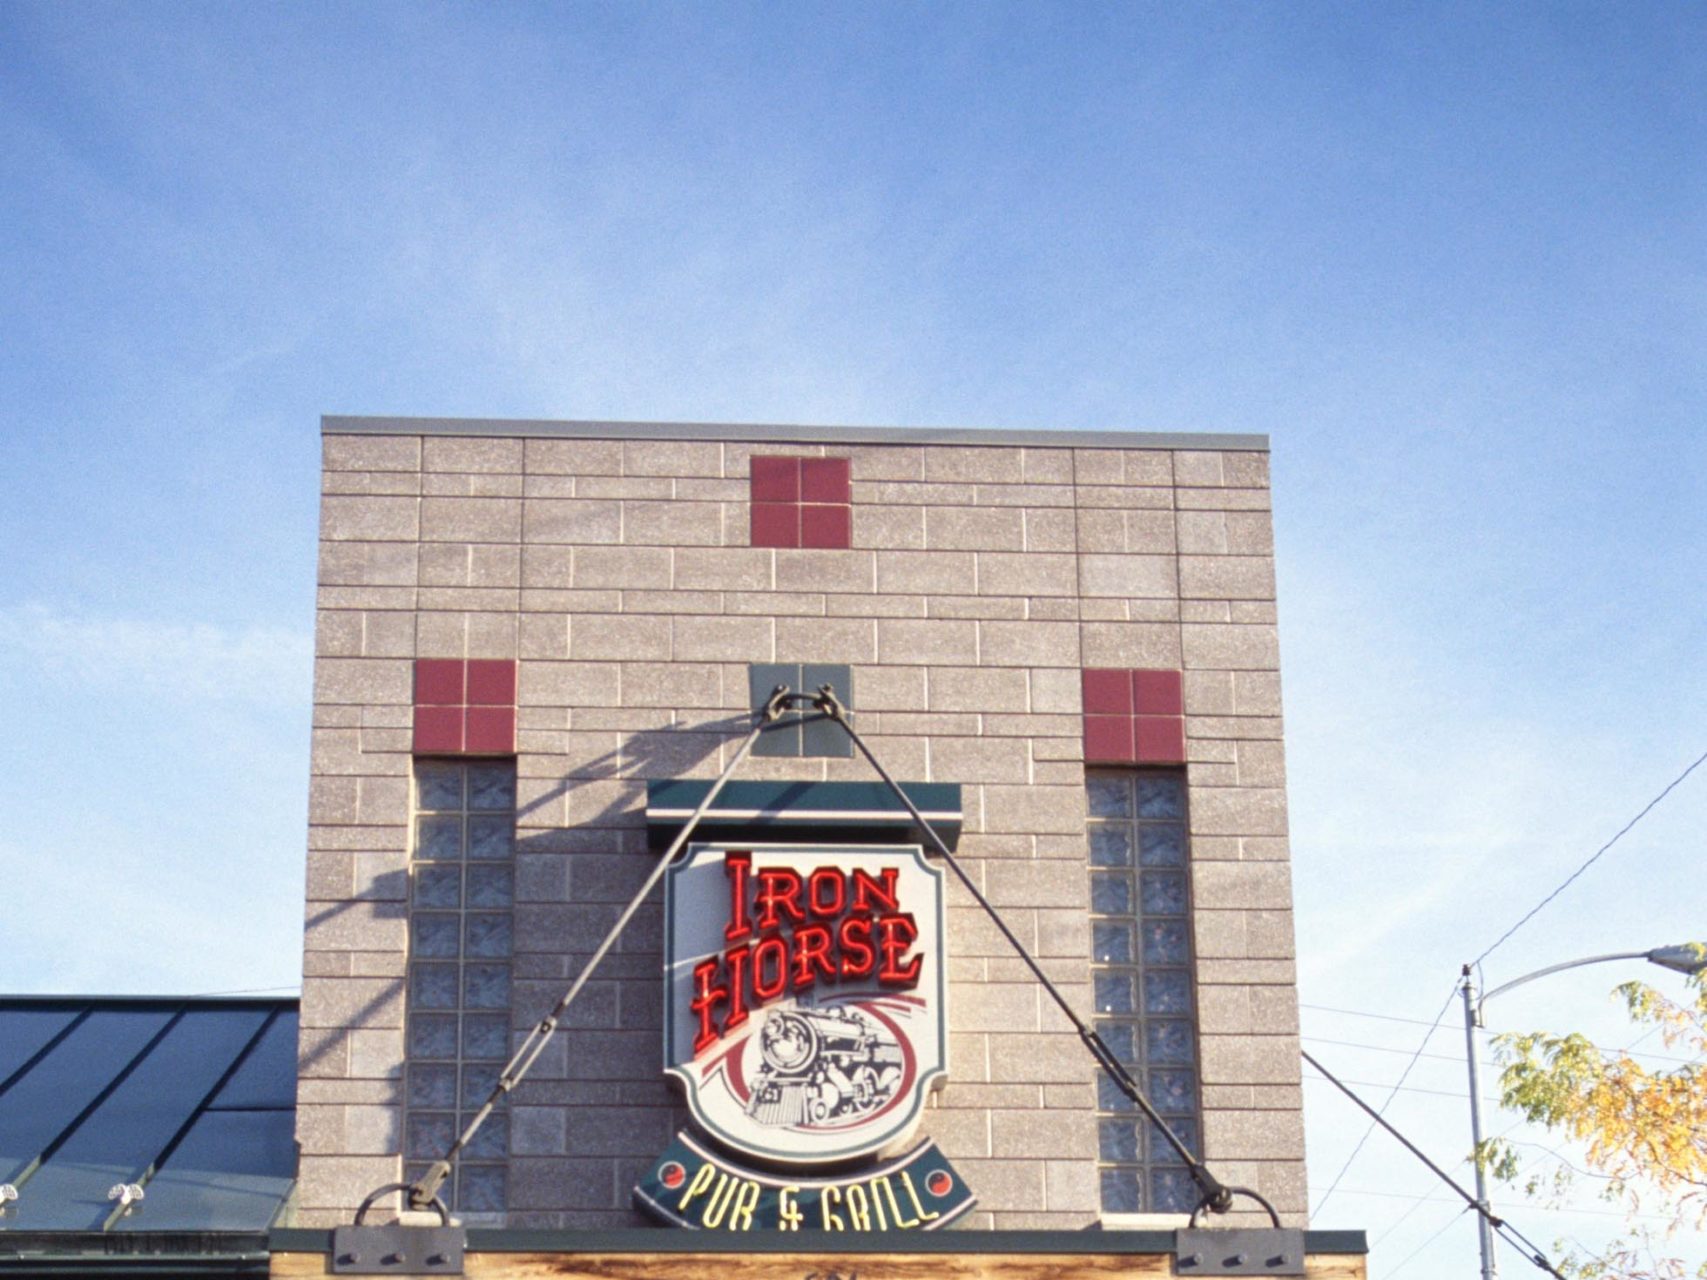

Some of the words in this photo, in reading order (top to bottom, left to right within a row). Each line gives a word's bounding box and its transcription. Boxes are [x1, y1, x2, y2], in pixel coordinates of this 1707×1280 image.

[723, 851, 900, 942] IRON
[691, 910, 924, 1058] HORSE
[678, 1162, 761, 1231] PUB
[779, 1186, 803, 1231] &
[821, 1170, 940, 1231] GRILL
